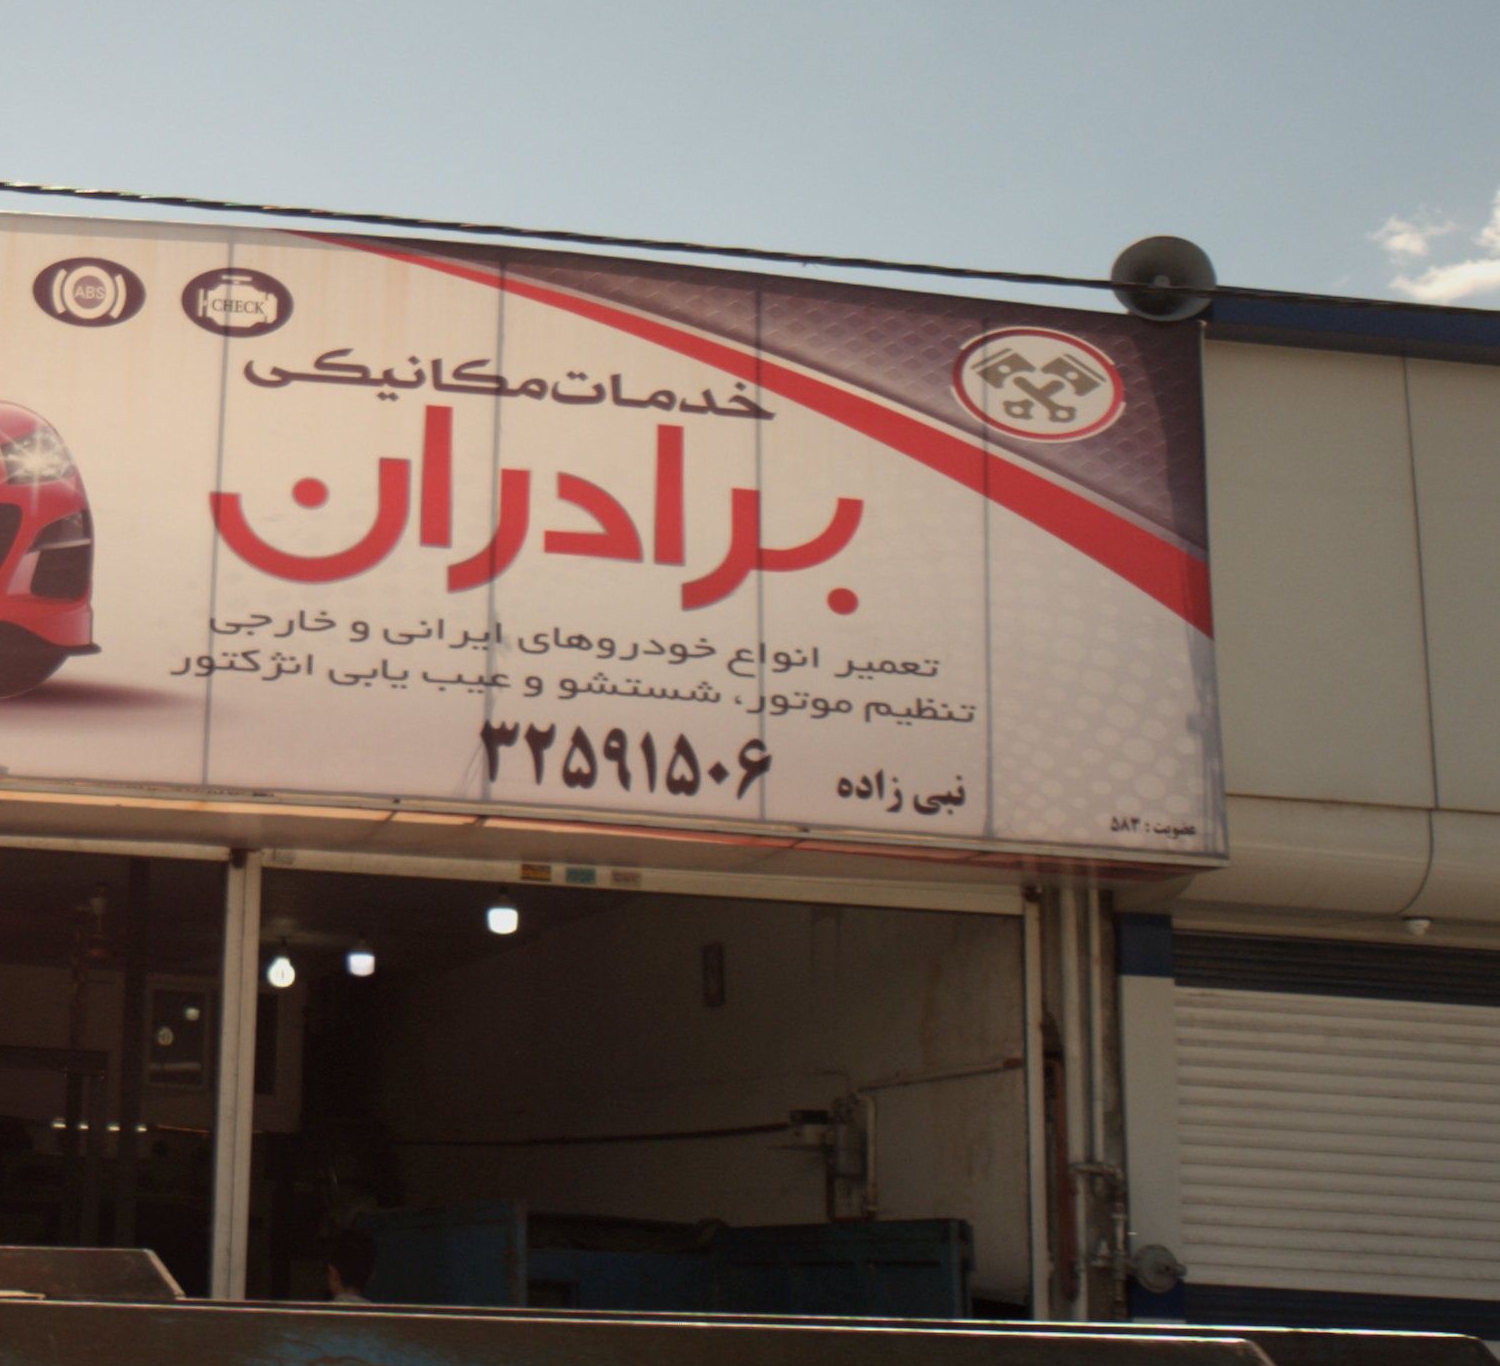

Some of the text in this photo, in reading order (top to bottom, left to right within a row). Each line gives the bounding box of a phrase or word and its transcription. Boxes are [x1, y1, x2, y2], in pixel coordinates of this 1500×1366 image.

[73, 285, 107, 300] ABS
[211, 298, 266, 315] CHECK
[243, 347, 777, 421] خدمات مکانیکی
[209, 404, 865, 617] برادران
[209, 609, 941, 682] تعمیر انواع خودروهای ایرانی و خارجی
[172, 649, 314, 682] انژکتور
[328, 659, 409, 690] یابی
[422, 669, 512, 695] عیب
[524, 675, 544, 698] و
[558, 671, 721, 703] شستشو
[864, 696, 977, 727] تنظیم
[480, 719, 772, 800] ۳۲۵۹۱۵۰۶
[836, 768, 966, 815] نبی زاده
